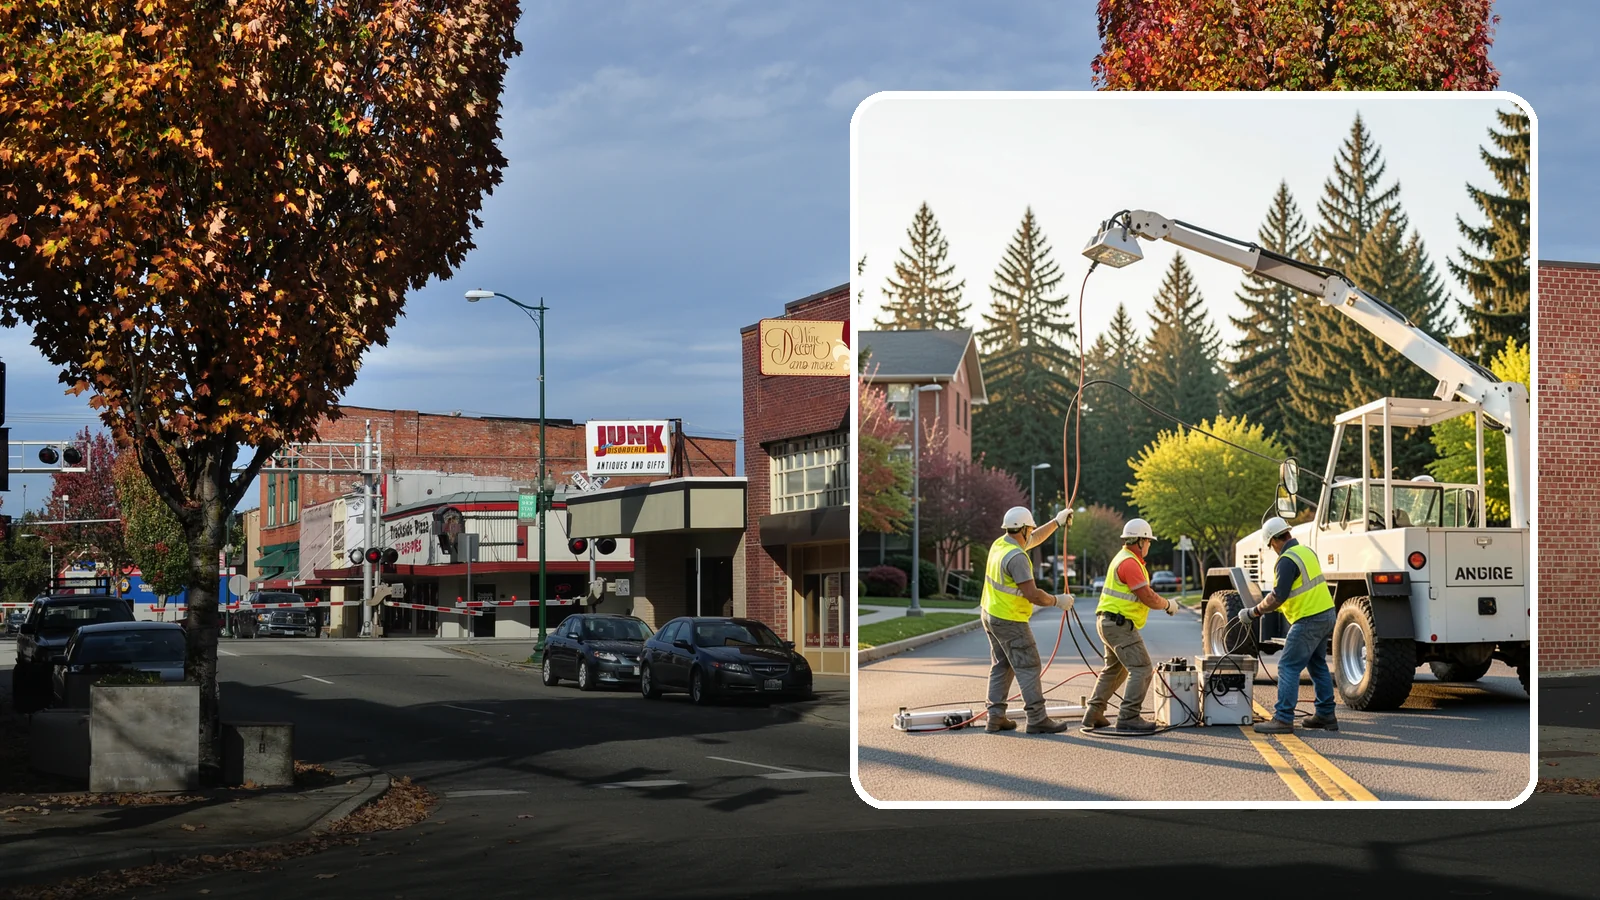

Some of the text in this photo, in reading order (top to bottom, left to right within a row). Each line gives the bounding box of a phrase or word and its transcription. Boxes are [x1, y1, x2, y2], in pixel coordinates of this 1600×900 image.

[765, 327, 831, 365] Decor
[595, 425, 666, 457] JUNK
[607, 446, 646, 454] DISORDERLY
[596, 460, 665, 470] ANTIQUES AND GIFTS
